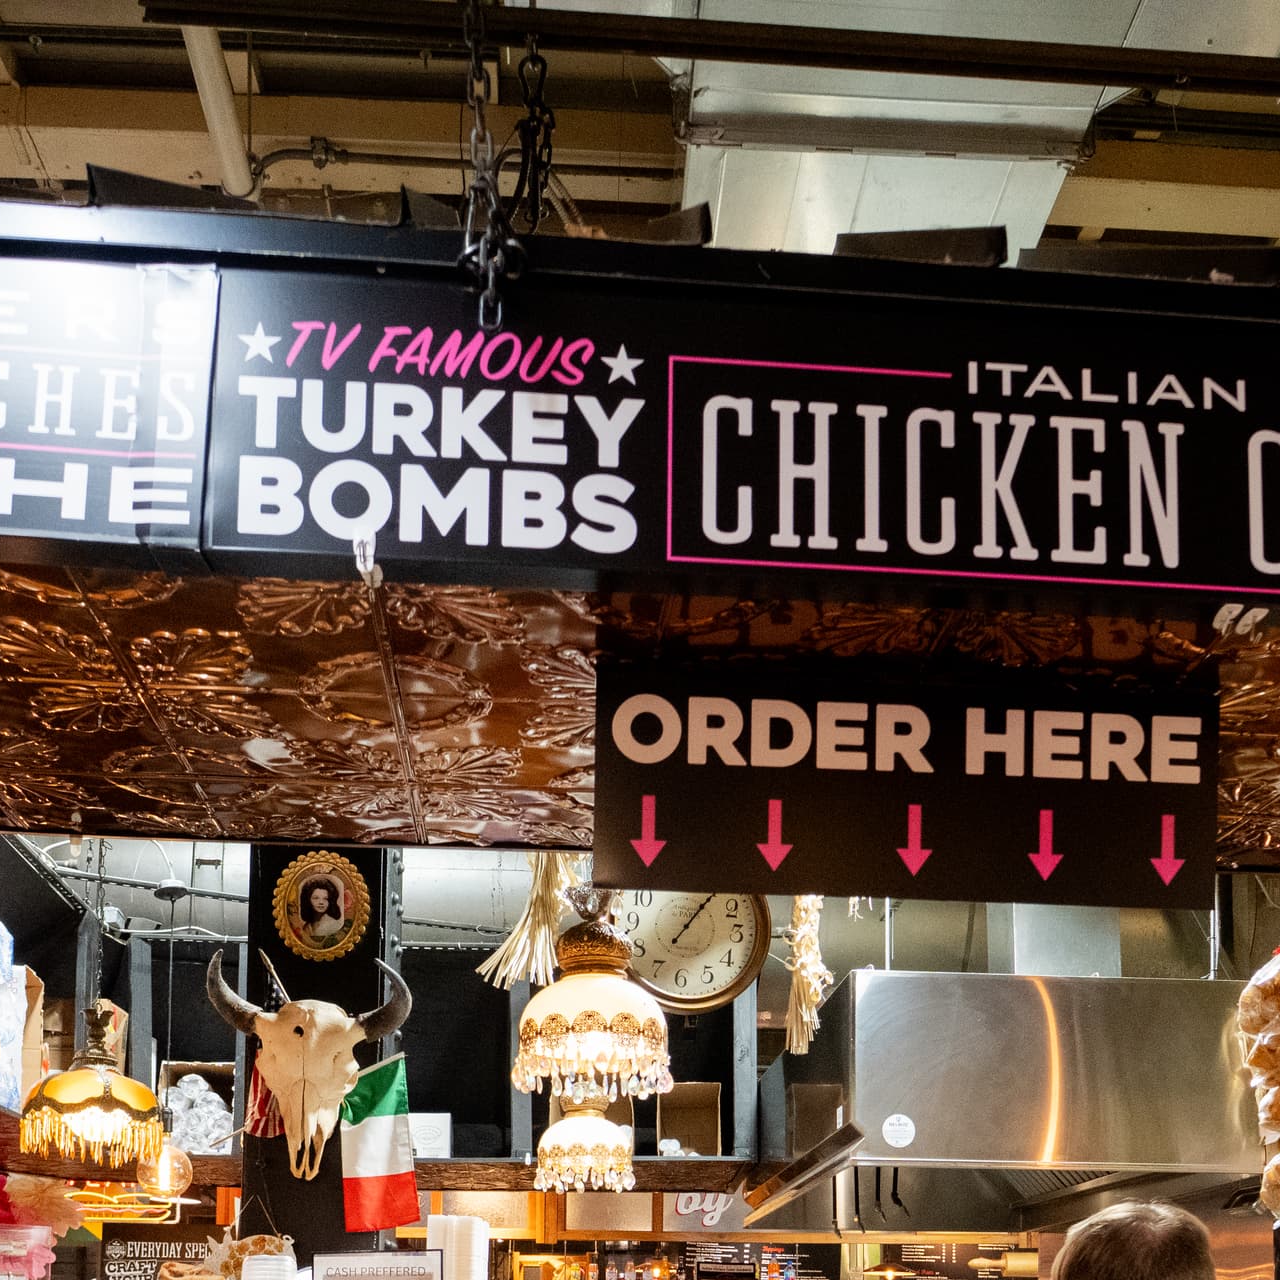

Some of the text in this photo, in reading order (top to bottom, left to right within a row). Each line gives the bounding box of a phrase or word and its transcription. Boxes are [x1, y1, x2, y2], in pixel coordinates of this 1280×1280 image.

[285, 320, 595, 387] TV FAMOUS
[967, 361, 1246, 411] ITALIAN
[238, 375, 646, 469] TURKEY
[237, 455, 638, 554] BOMBS
[701, 395, 1185, 569] CHICKEN
[611, 693, 1202, 785] ORDER HERE
[105, 1259, 158, 1275] CRAFT
[127, 1241, 182, 1258] EVERYDAY
[326, 1266, 426, 1277] CASH PREFFERED
